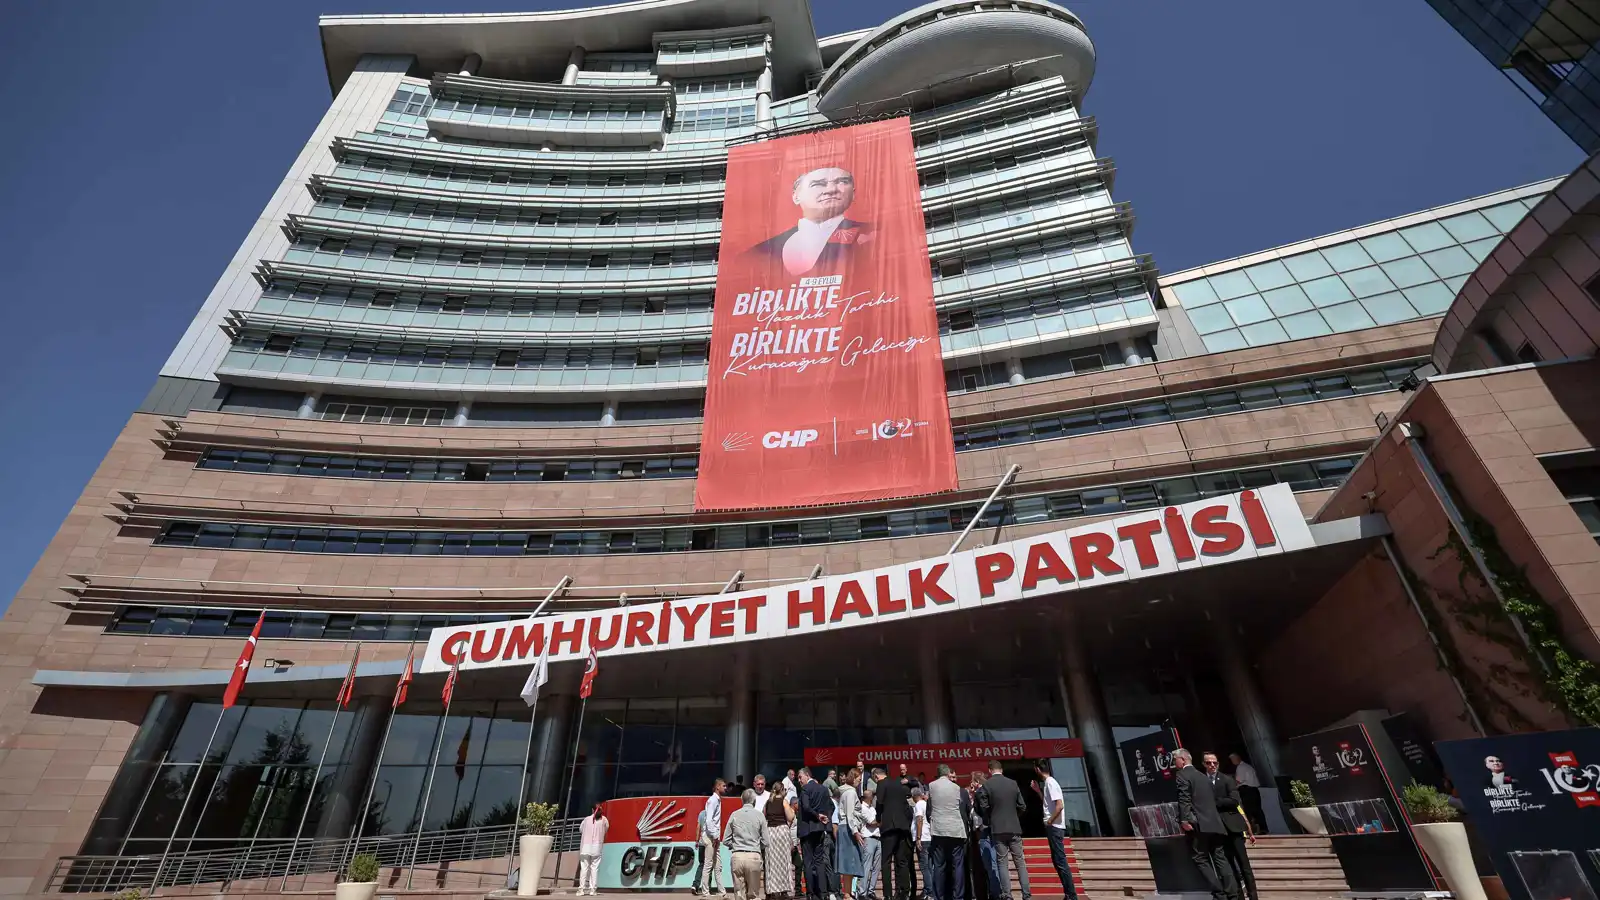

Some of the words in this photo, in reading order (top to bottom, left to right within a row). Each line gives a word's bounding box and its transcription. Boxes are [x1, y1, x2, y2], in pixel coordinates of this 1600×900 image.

[818, 276, 837, 285] EYLÜL
[732, 283, 841, 316] BİRLİKTE
[757, 304, 830, 330] Yazdık
[835, 290, 900, 323] Tarihi
[729, 324, 842, 357] BİRLİKTE
[723, 352, 835, 380] Kuracağız
[841, 335, 931, 367] Geleceği
[762, 428, 819, 449] CHP
[440, 595, 767, 666] CUMHURİYET
[787, 562, 956, 630] HALK
[974, 489, 1277, 599] PARTİSİ
[857, 747, 935, 763] CUMHURİYET
[938, 747, 972, 759] HALK
[975, 745, 1024, 758] PARTİSİ
[1483, 786, 1515, 797] BİRLİKTE
[1489, 798, 1521, 808] BİRLİKTE
[621, 846, 695, 884] CHP
